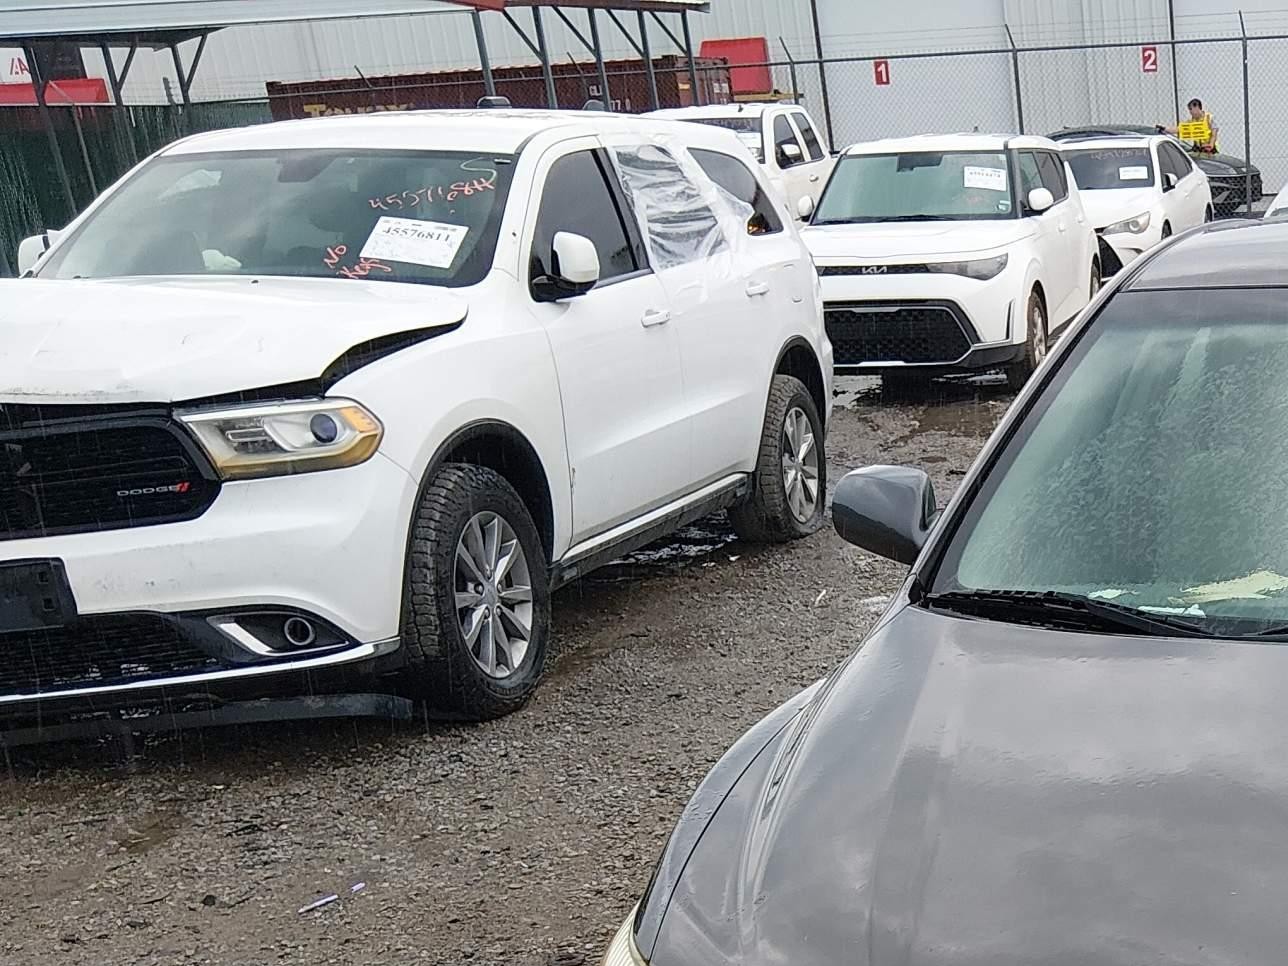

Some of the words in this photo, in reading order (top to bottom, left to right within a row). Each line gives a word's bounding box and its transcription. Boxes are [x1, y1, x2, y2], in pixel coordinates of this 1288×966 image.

[1143, 49, 1156, 70] 2
[876, 63, 887, 82] 1
[116, 484, 178, 497] DODGE
